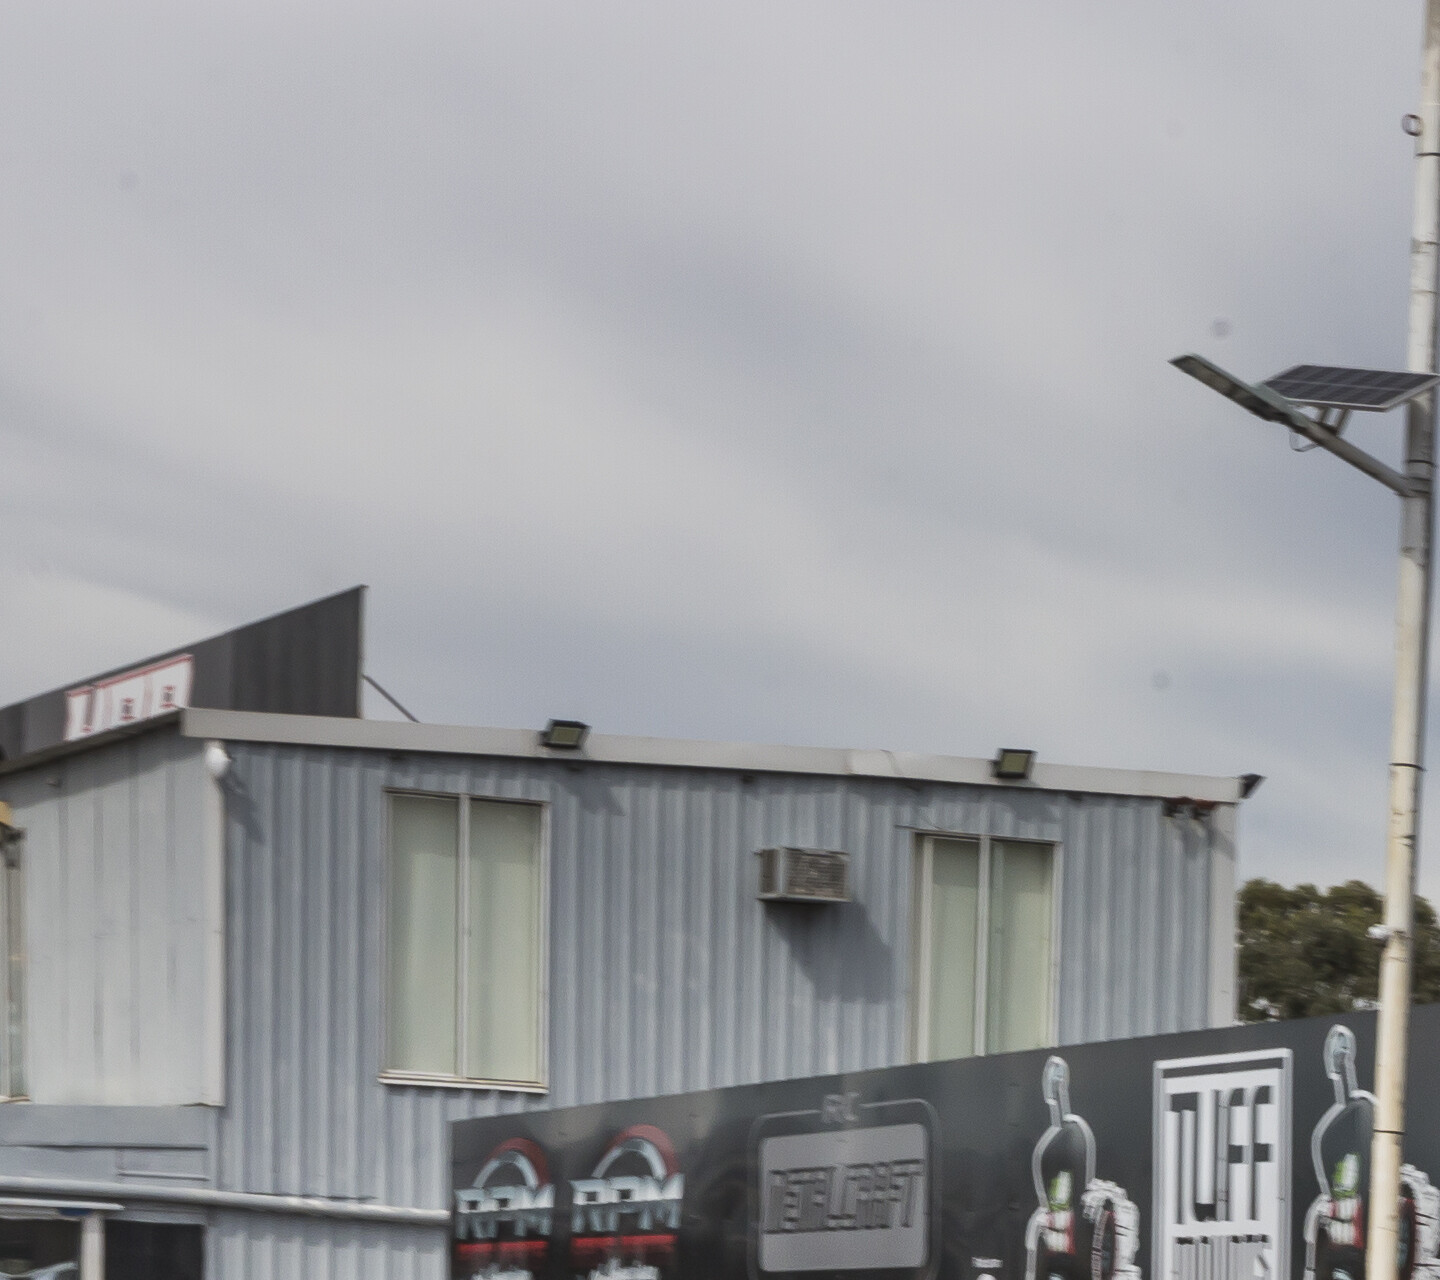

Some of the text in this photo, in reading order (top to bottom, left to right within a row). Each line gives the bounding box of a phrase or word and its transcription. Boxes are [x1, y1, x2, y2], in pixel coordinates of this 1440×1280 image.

[1169, 1085, 1272, 1225] TUFF
[455, 1183, 556, 1239] RPM
[569, 1173, 685, 1233] RPM
